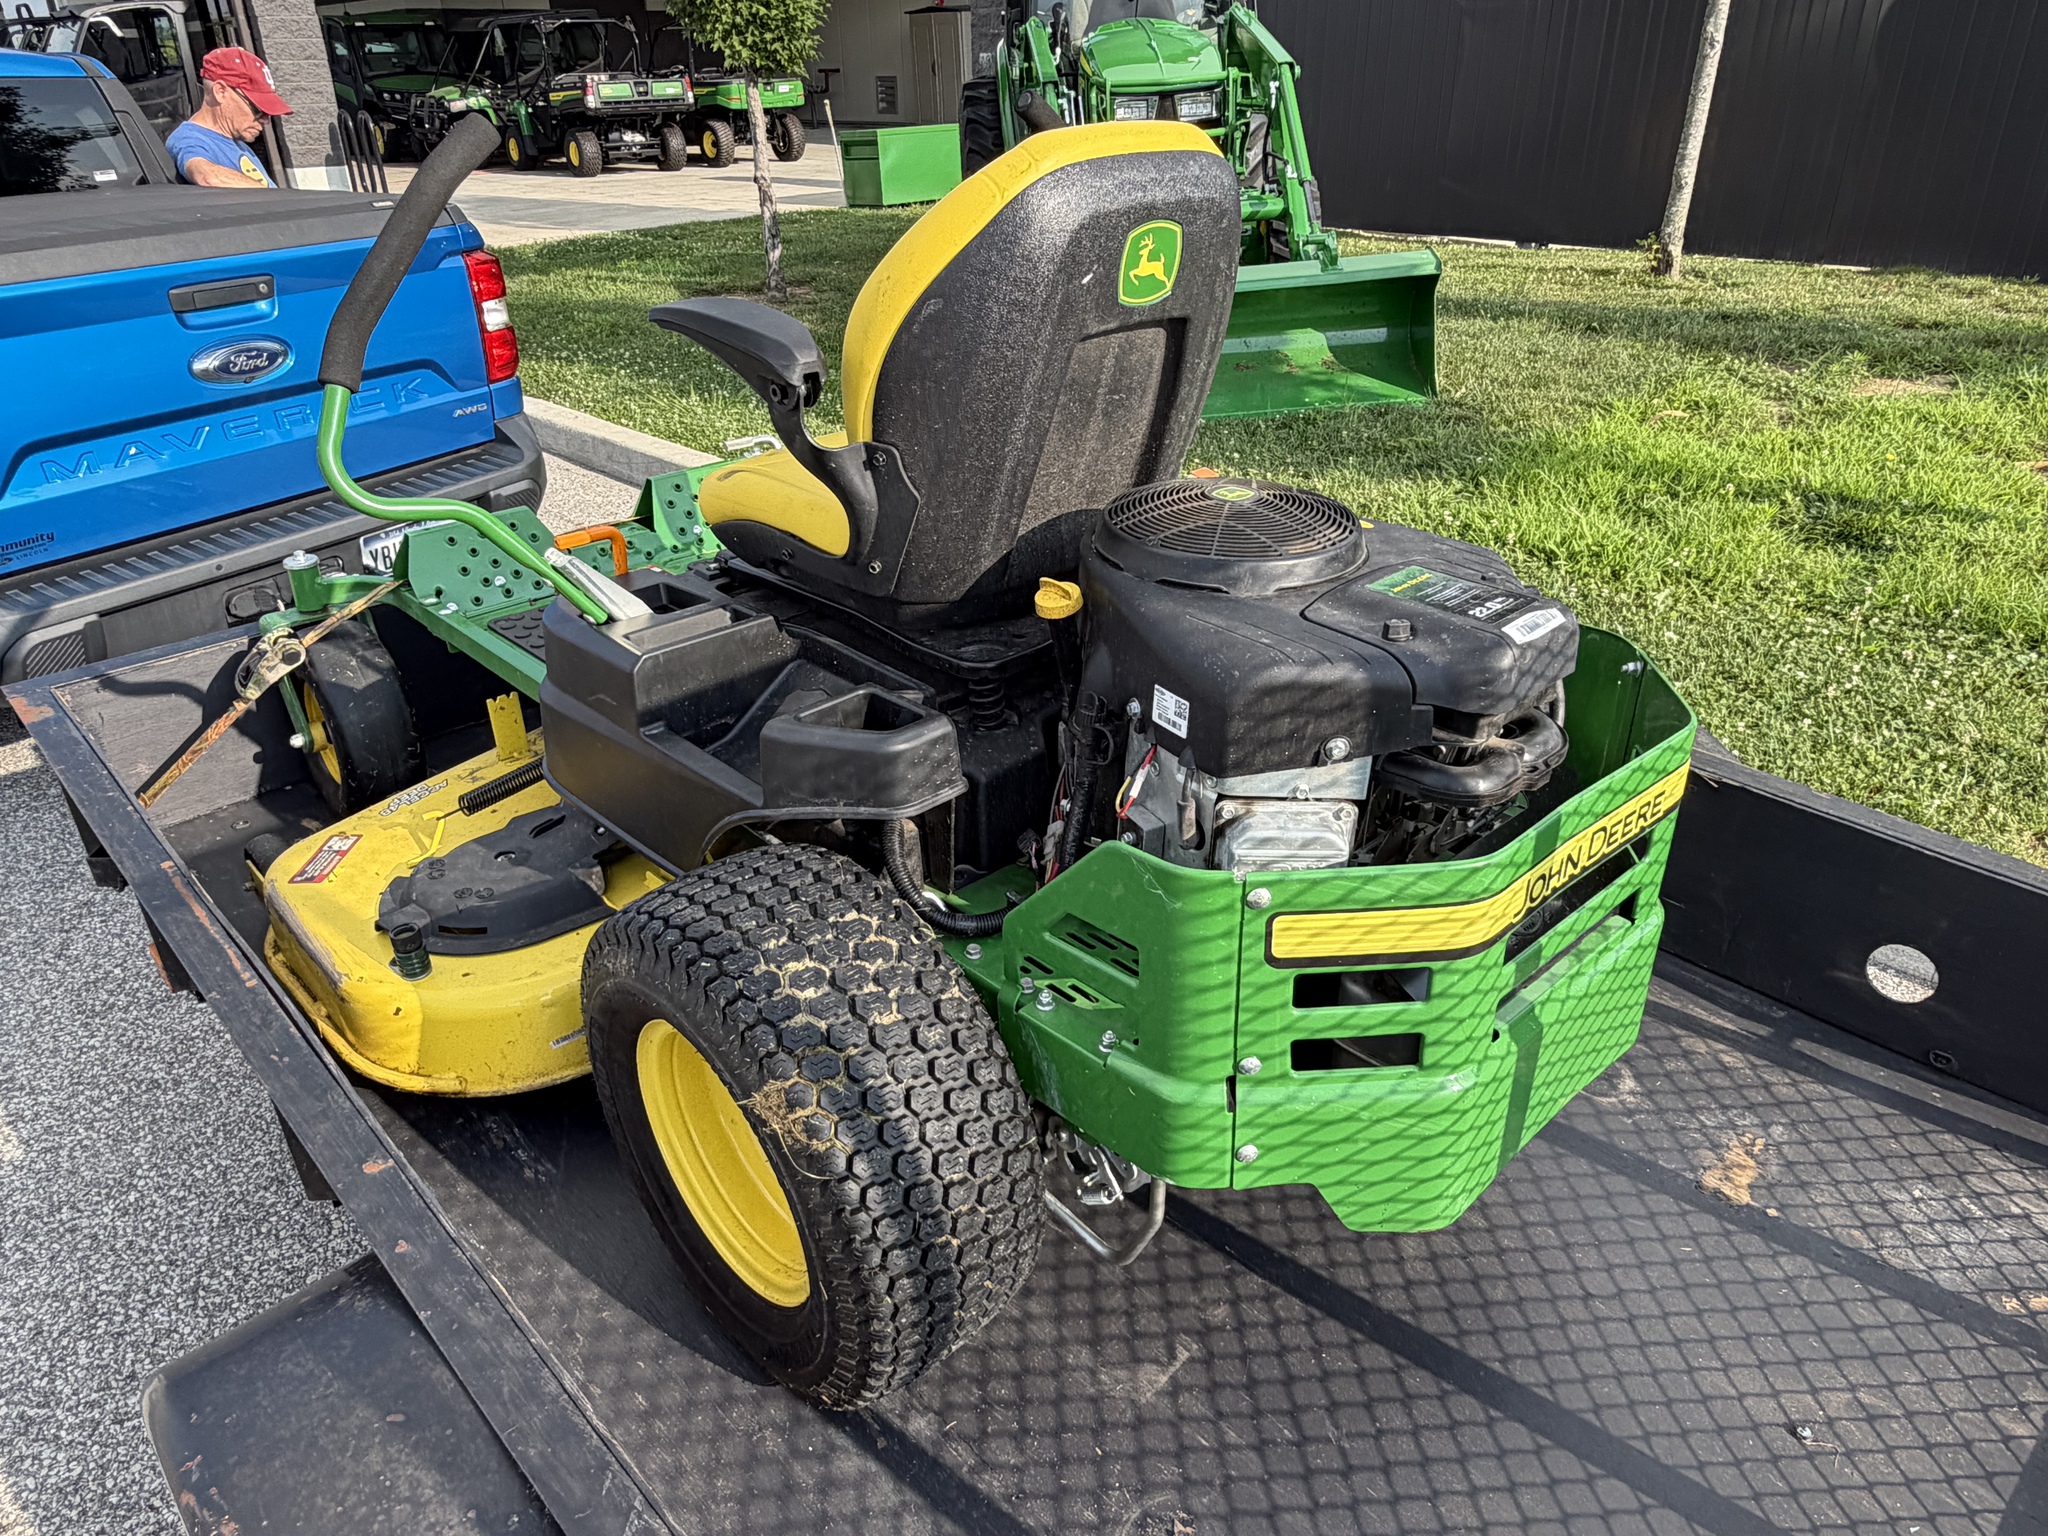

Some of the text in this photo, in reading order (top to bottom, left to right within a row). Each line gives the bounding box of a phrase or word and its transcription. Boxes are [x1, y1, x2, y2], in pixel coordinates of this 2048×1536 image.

[229, 350, 269, 373] Ford
[453, 402, 488, 418] AWD
[40, 376, 430, 484] MAVERCK
[16, 547, 49, 560] LINCOLN
[1512, 789, 1667, 921] JOHN DEERE
